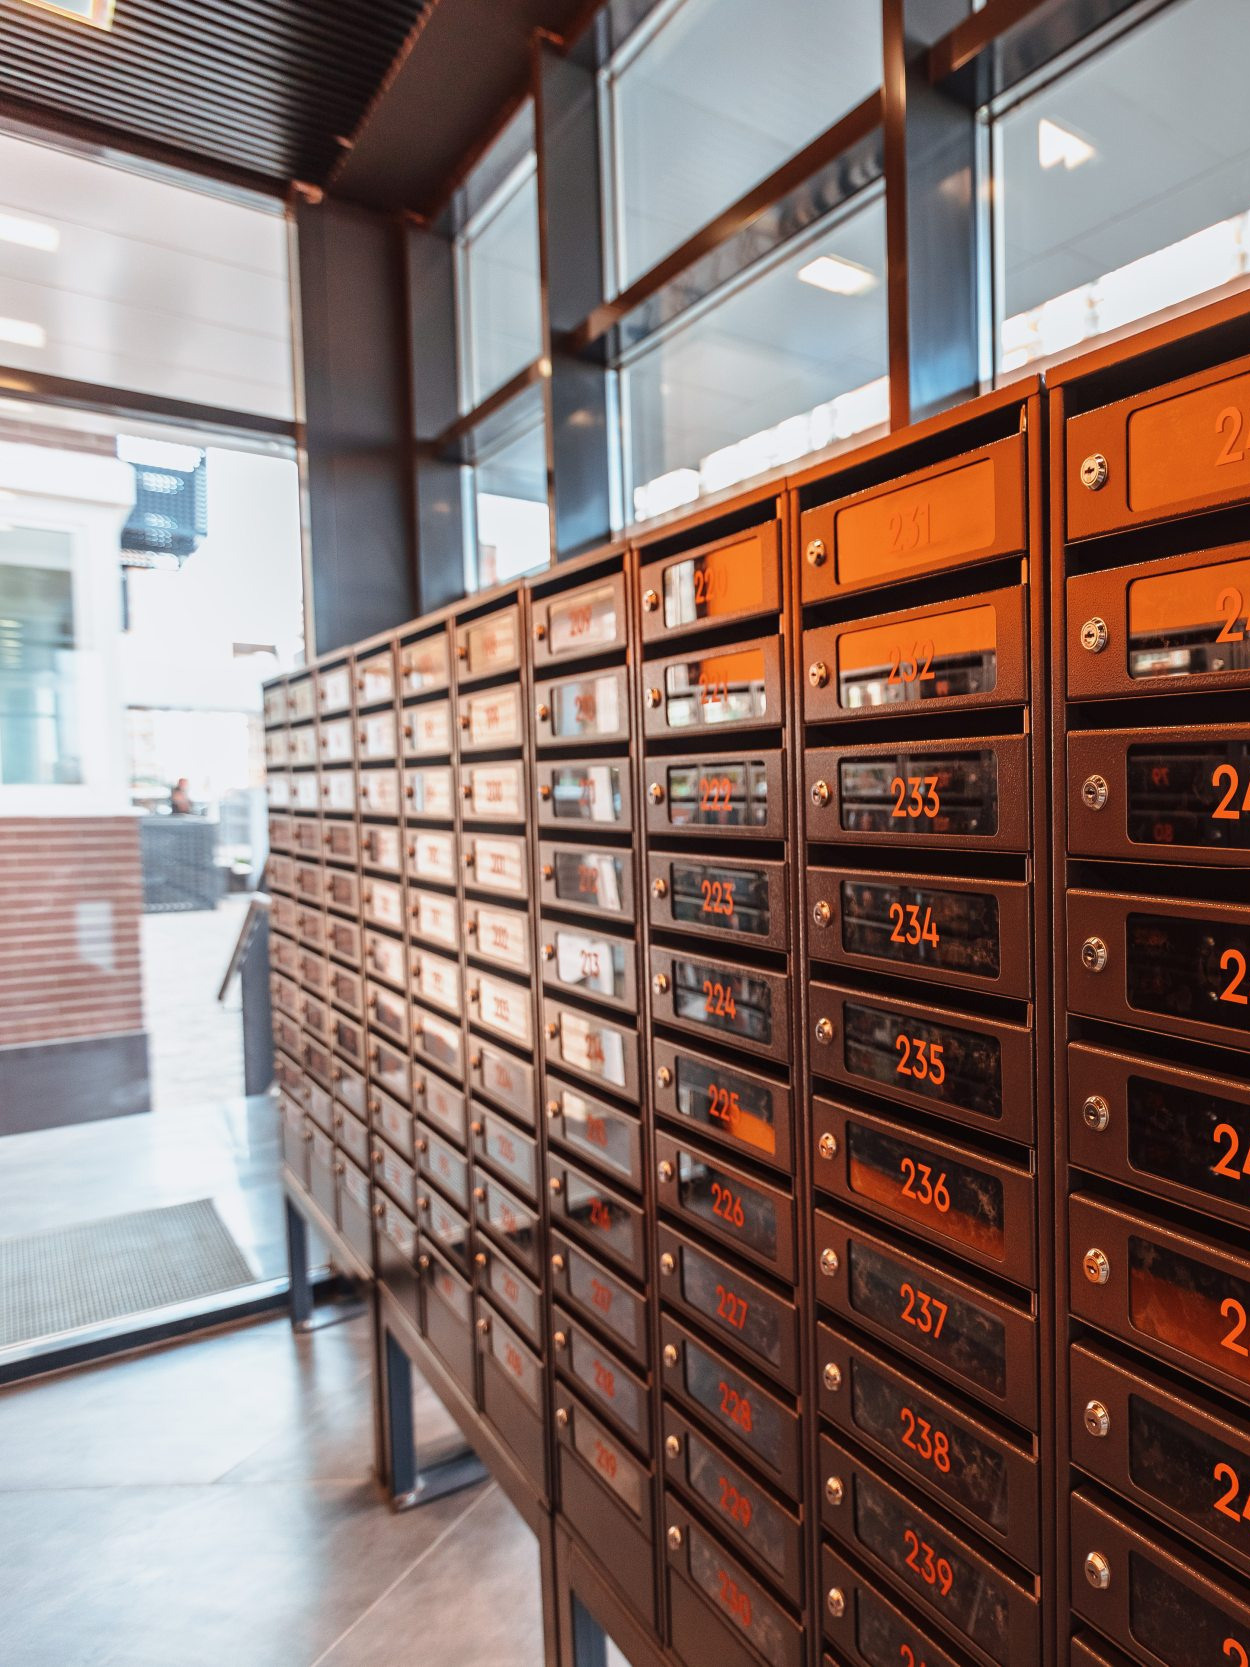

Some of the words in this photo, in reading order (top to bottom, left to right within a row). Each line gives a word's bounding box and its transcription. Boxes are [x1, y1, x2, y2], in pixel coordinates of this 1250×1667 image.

[888, 503, 932, 550] 231
[888, 639, 935, 685] 232
[699, 672, 729, 705] 221
[700, 777, 732, 811] 222
[891, 776, 940, 818] 233
[701, 879, 734, 916] 223
[889, 902, 940, 948] 234
[580, 950, 600, 977] 213
[703, 980, 736, 1019] 224
[895, 1034, 946, 1085] 235
[708, 1083, 741, 1126] 225
[711, 1183, 744, 1227] 226
[901, 1157, 950, 1213] 236
[716, 1285, 748, 1329] 227
[900, 1283, 948, 1338] 237
[719, 1381, 752, 1432] 228
[901, 1407, 950, 1472] 238
[904, 1529, 953, 1596] 239
